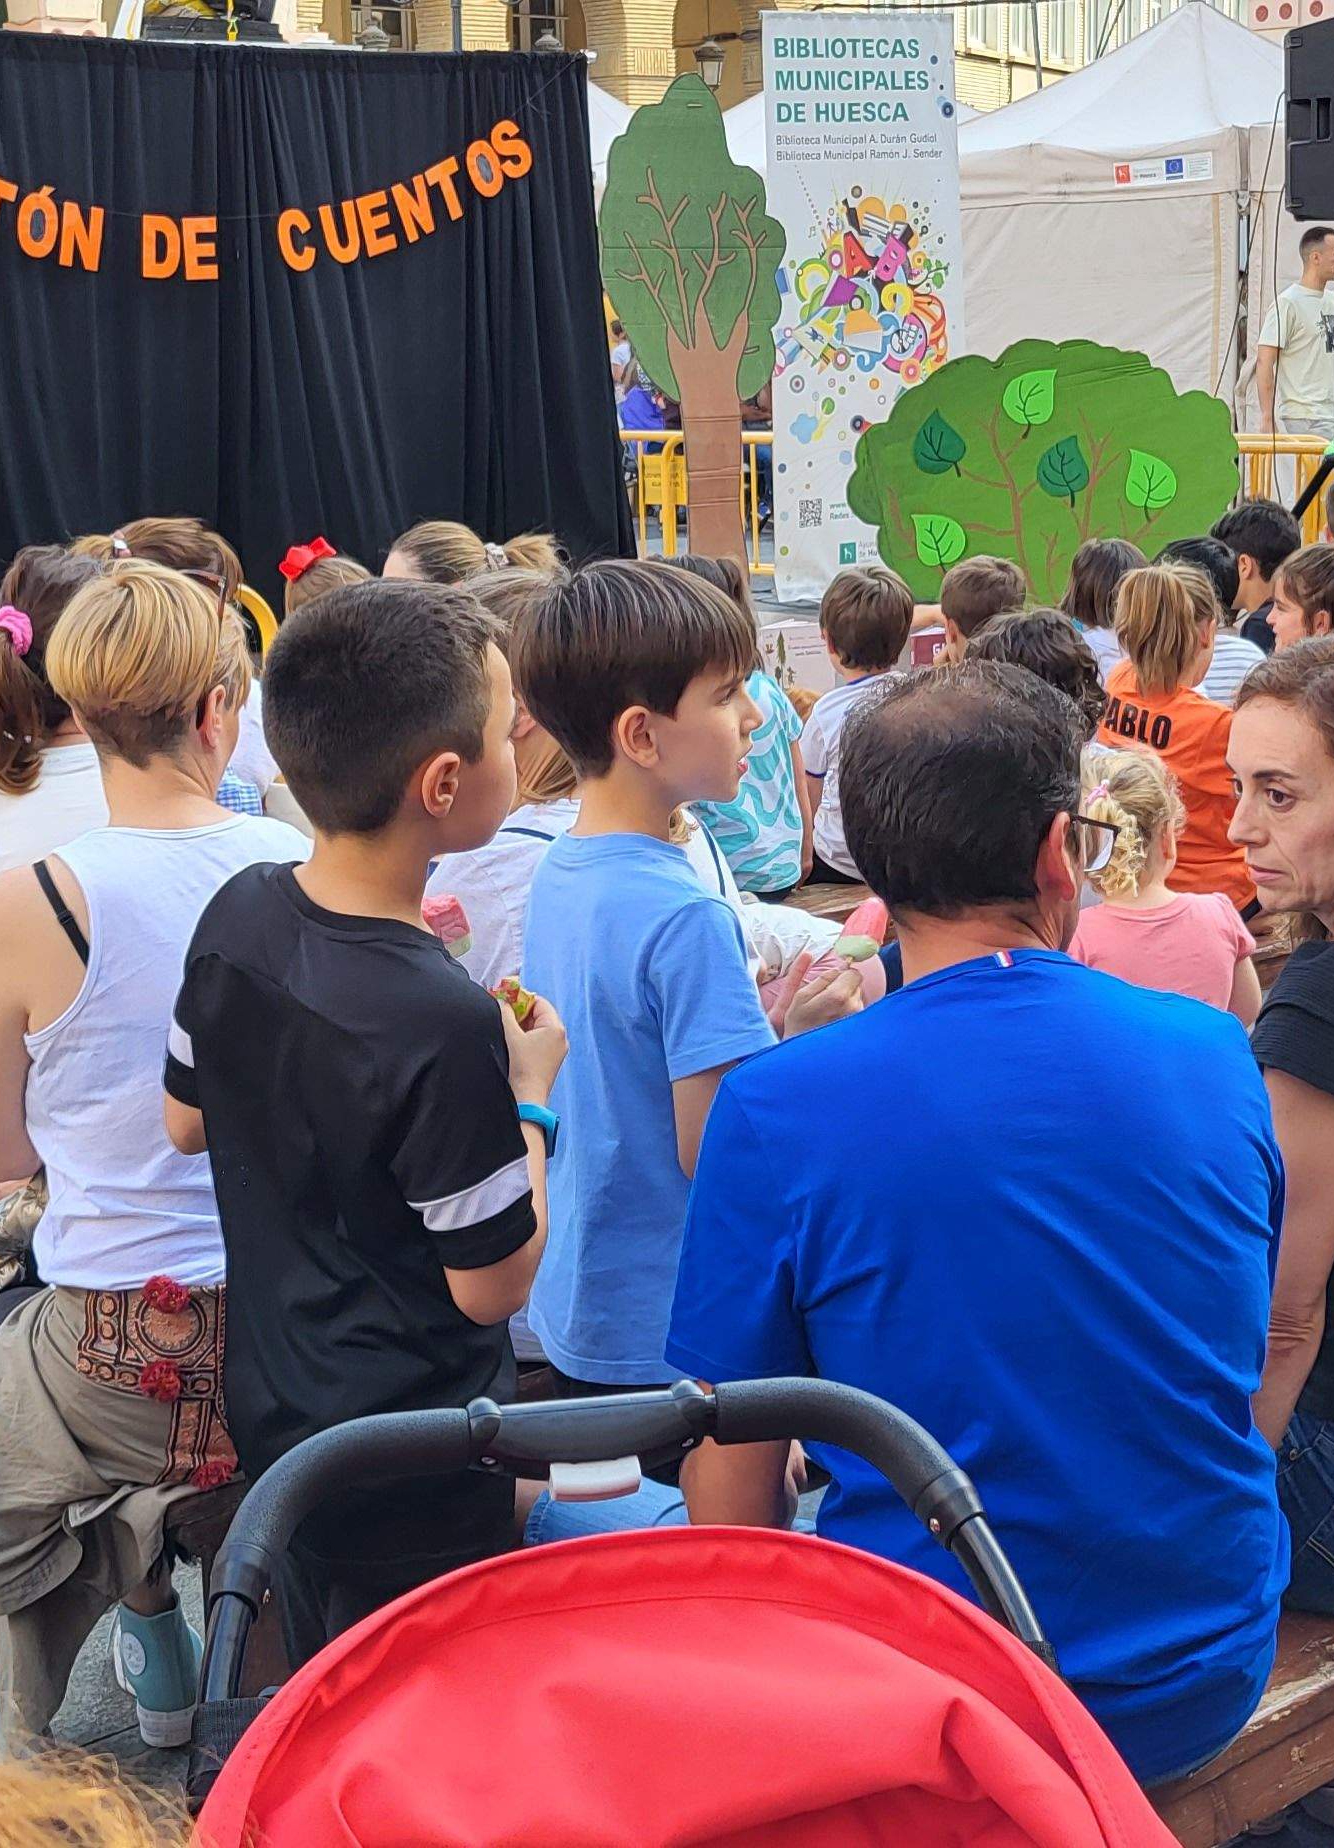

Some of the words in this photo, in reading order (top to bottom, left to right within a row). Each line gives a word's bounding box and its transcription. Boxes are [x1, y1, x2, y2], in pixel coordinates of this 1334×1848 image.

[774, 38, 920, 59] BIBLIOTECAS
[775, 70, 929, 91] MUNICIPALES
[776, 102, 806, 123] DE
[815, 102, 910, 123] HUESCA
[776, 135, 820, 146] Biblioteca
[823, 134, 866, 146] Municipal
[776, 151, 821, 161] Biblioteca
[823, 150, 867, 162] Municipal
[870, 149, 900, 159] Ramón
[913, 148, 942, 159] Sender
[142, 213, 219, 281] DE
[277, 119, 533, 272] CUENTOS
[1104, 694, 1172, 750] ABLO
